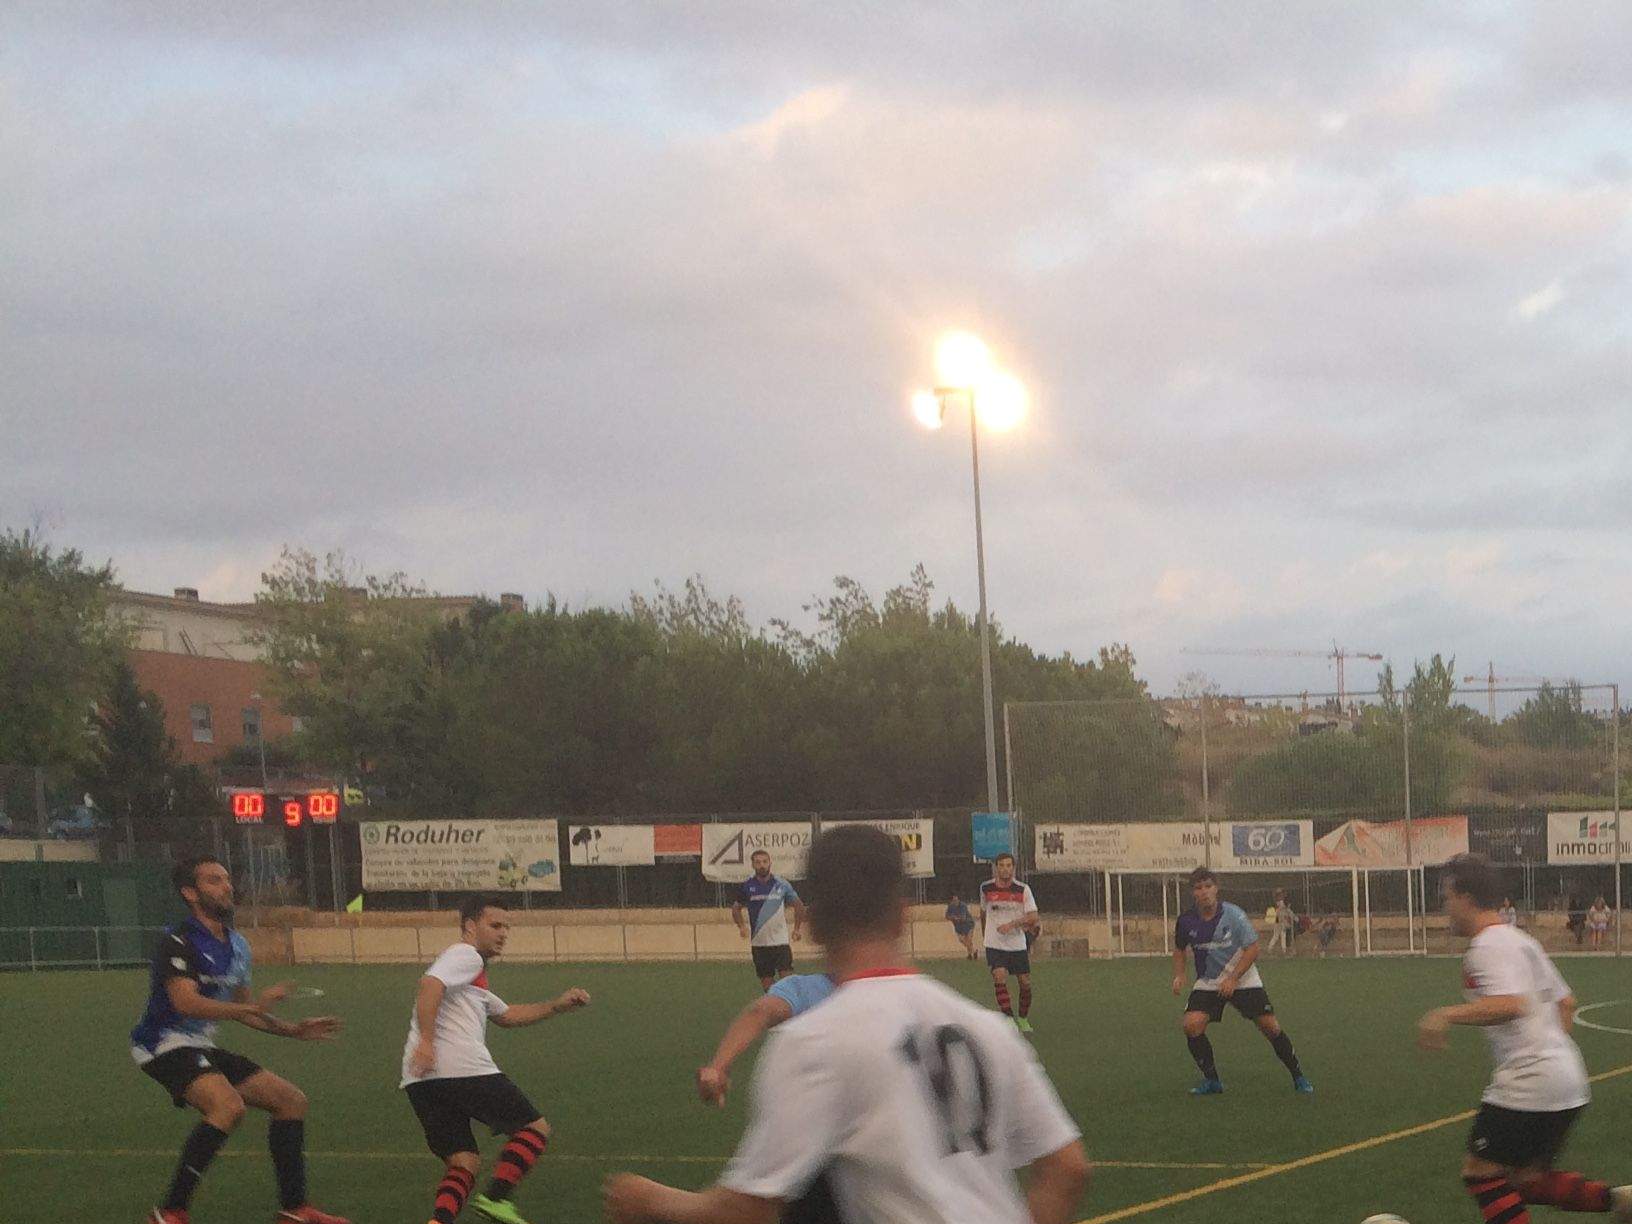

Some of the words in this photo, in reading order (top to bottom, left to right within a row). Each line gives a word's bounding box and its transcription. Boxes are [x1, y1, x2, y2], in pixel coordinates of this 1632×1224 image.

[234, 794, 263, 816] 00
[309, 795, 337, 816] 00
[385, 823, 485, 845] Roduher
